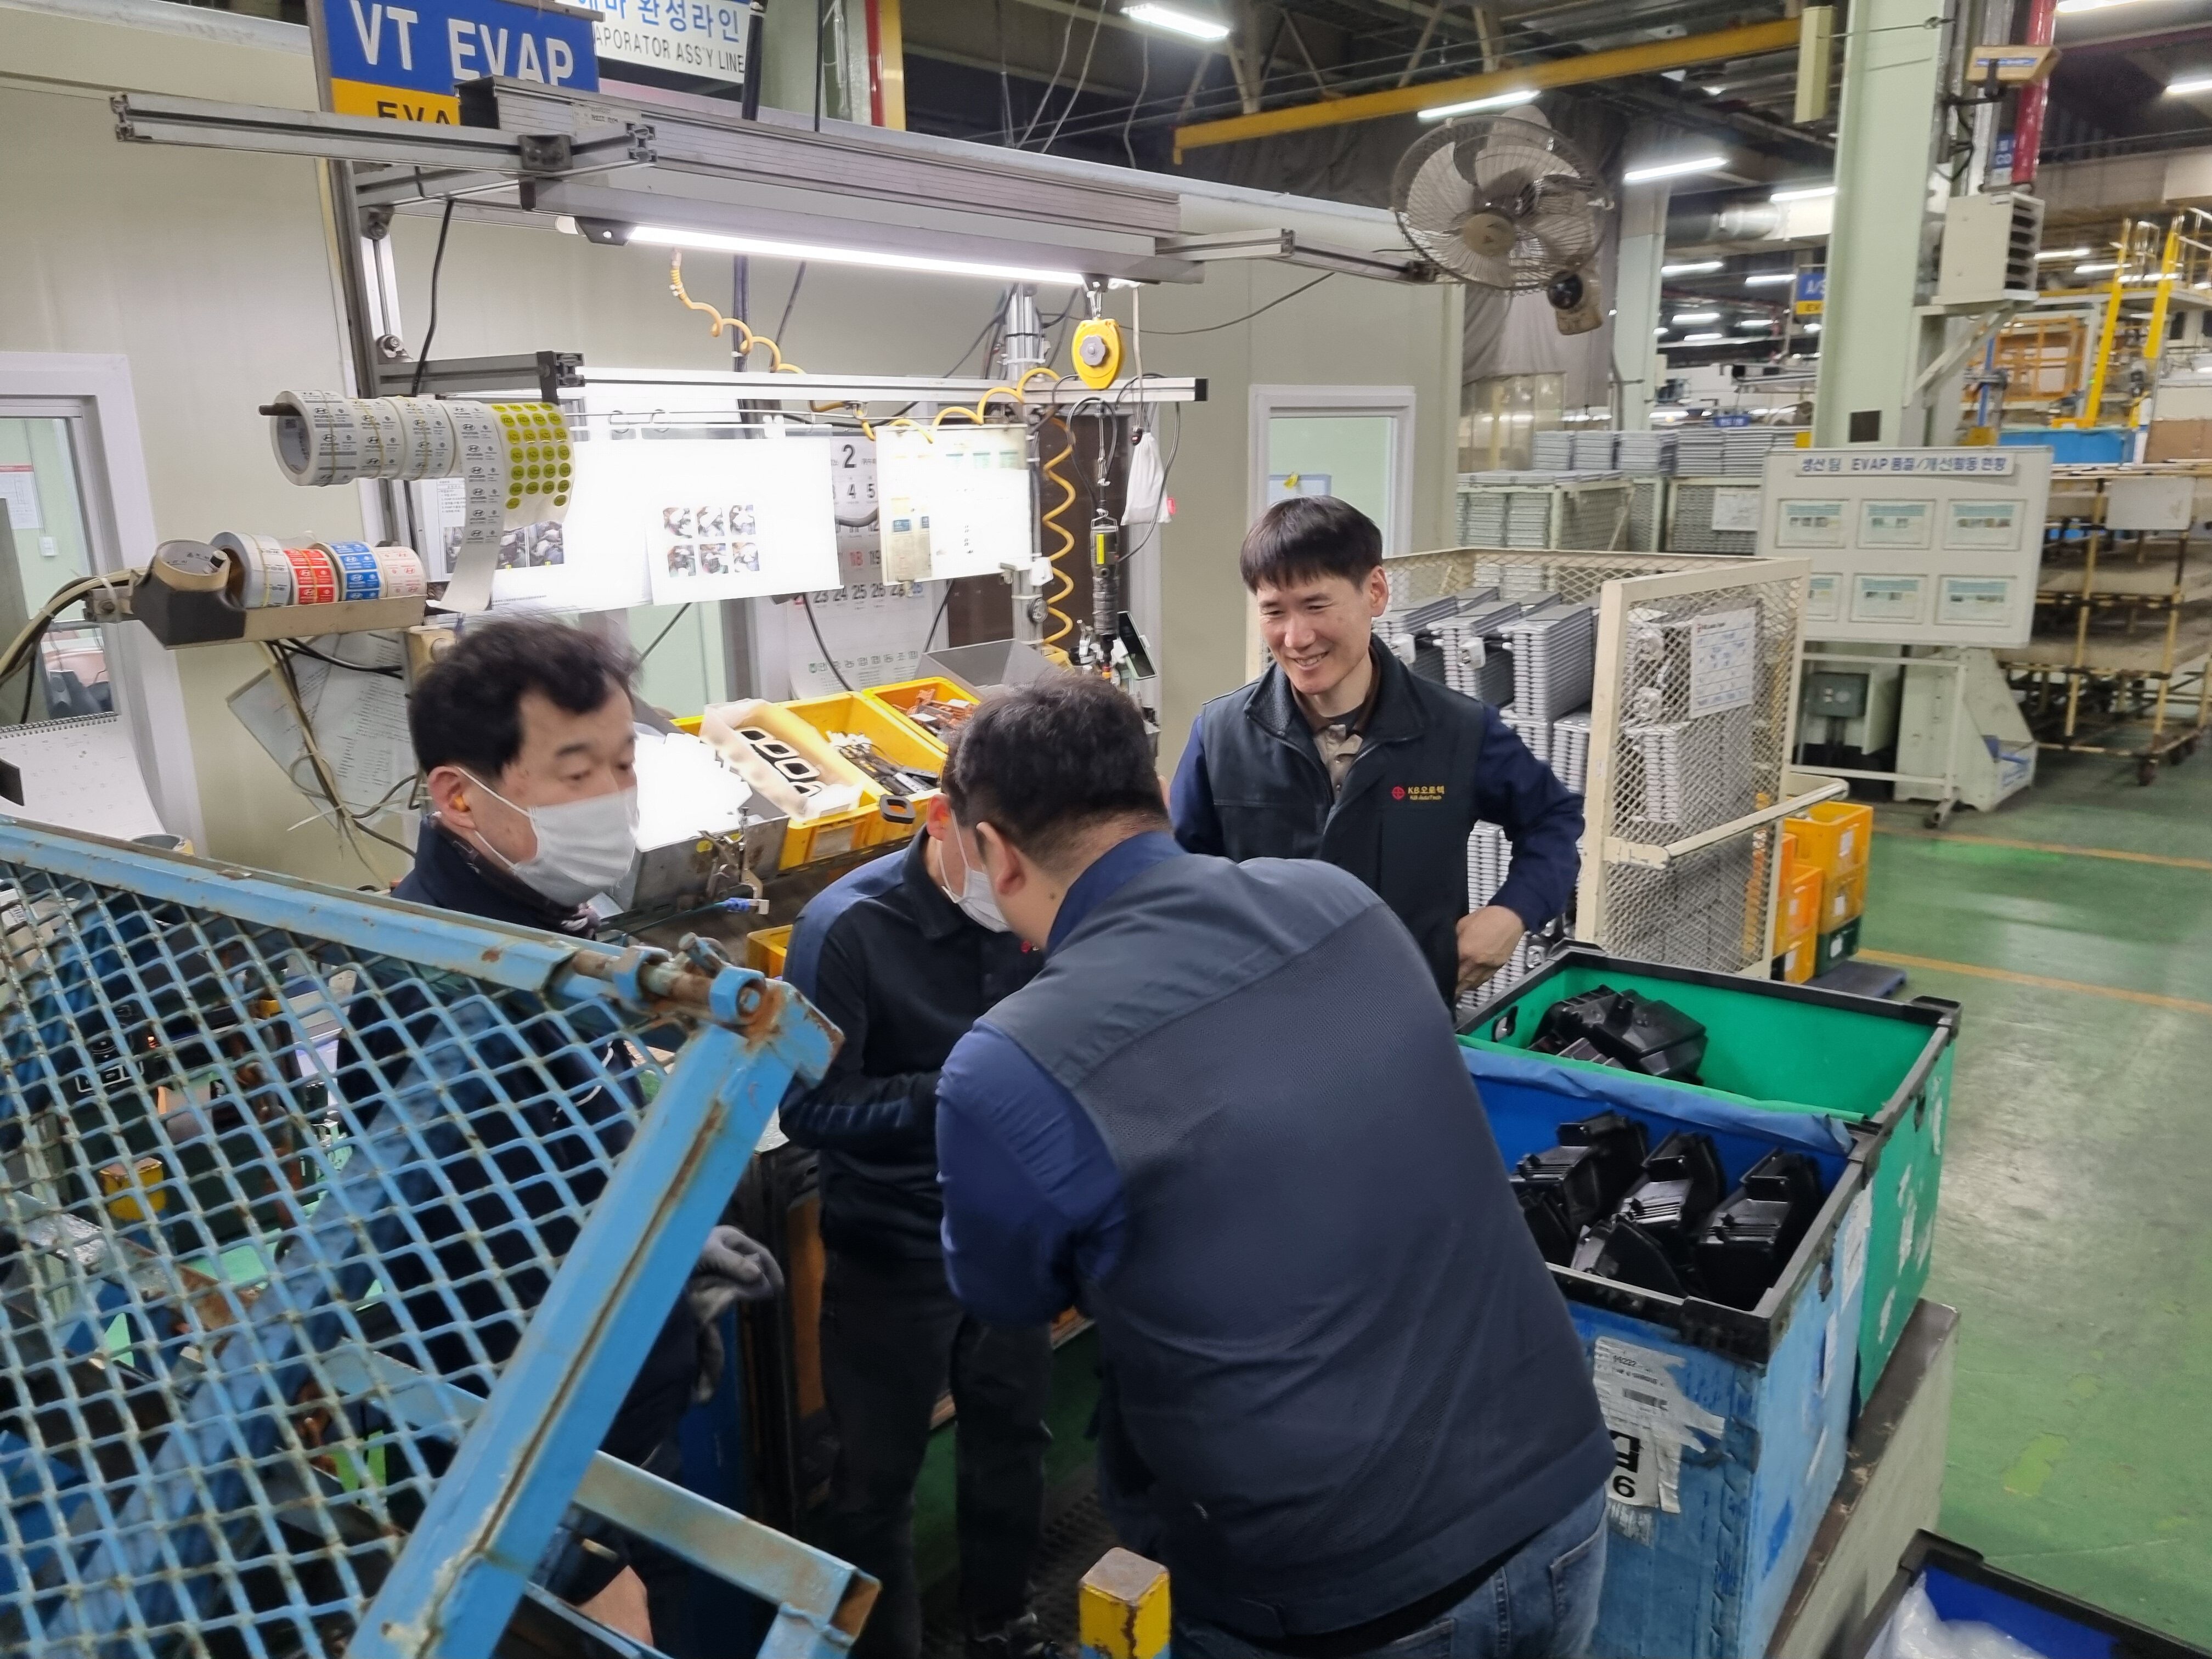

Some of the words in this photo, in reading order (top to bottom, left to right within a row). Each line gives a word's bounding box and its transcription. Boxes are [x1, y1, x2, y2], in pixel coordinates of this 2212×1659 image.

[637, 0, 740, 43] 완성라인
[349, 0, 418, 70] VT
[447, 18, 573, 86] EVAP
[718, 50, 745, 73] LINE
[842, 444, 857, 469] 2
[1851, 458, 1888, 471] EVAP
[847, 483, 856, 499] 4
[866, 483, 876, 499] 5
[851, 584, 867, 600] 25
